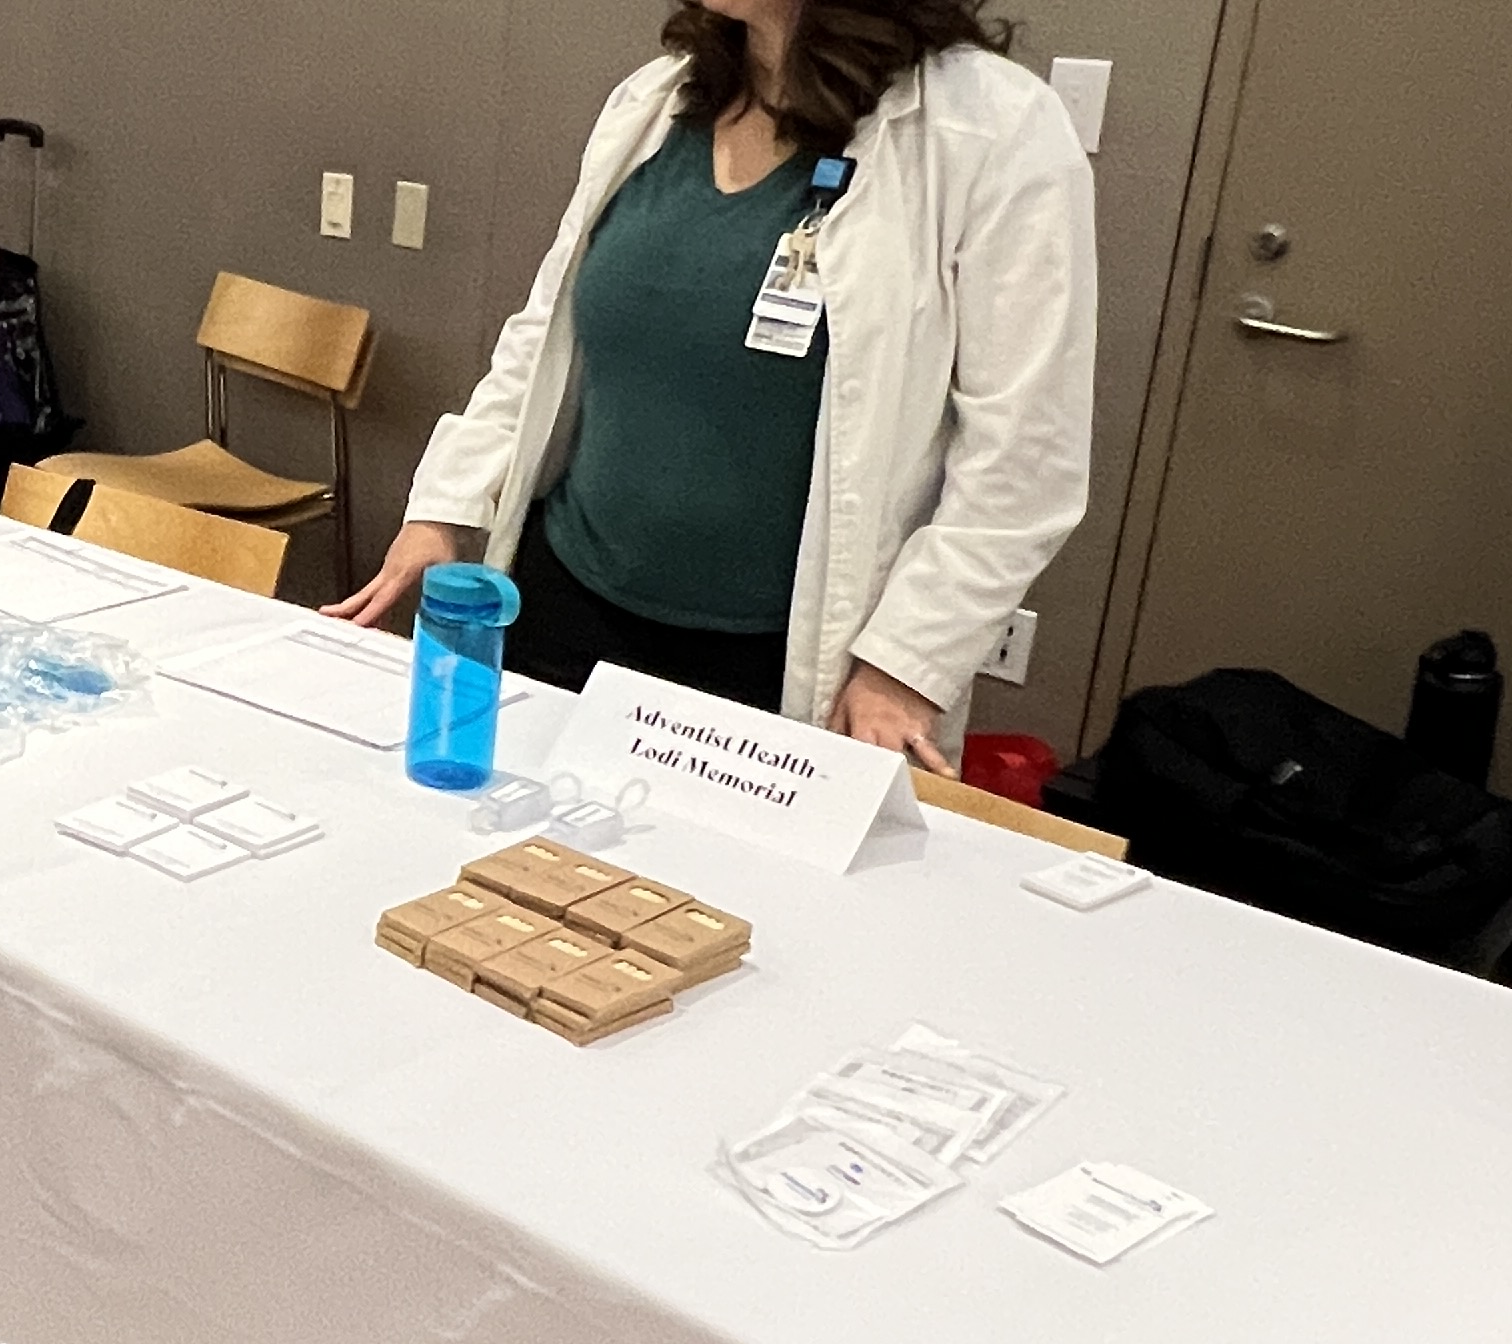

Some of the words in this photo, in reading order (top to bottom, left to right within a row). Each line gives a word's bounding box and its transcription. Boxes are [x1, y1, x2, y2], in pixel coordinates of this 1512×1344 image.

[627, 705, 734, 751] Adventist
[737, 739, 816, 779] Health
[629, 737, 683, 769] Lodi
[684, 756, 798, 807] Memorial
